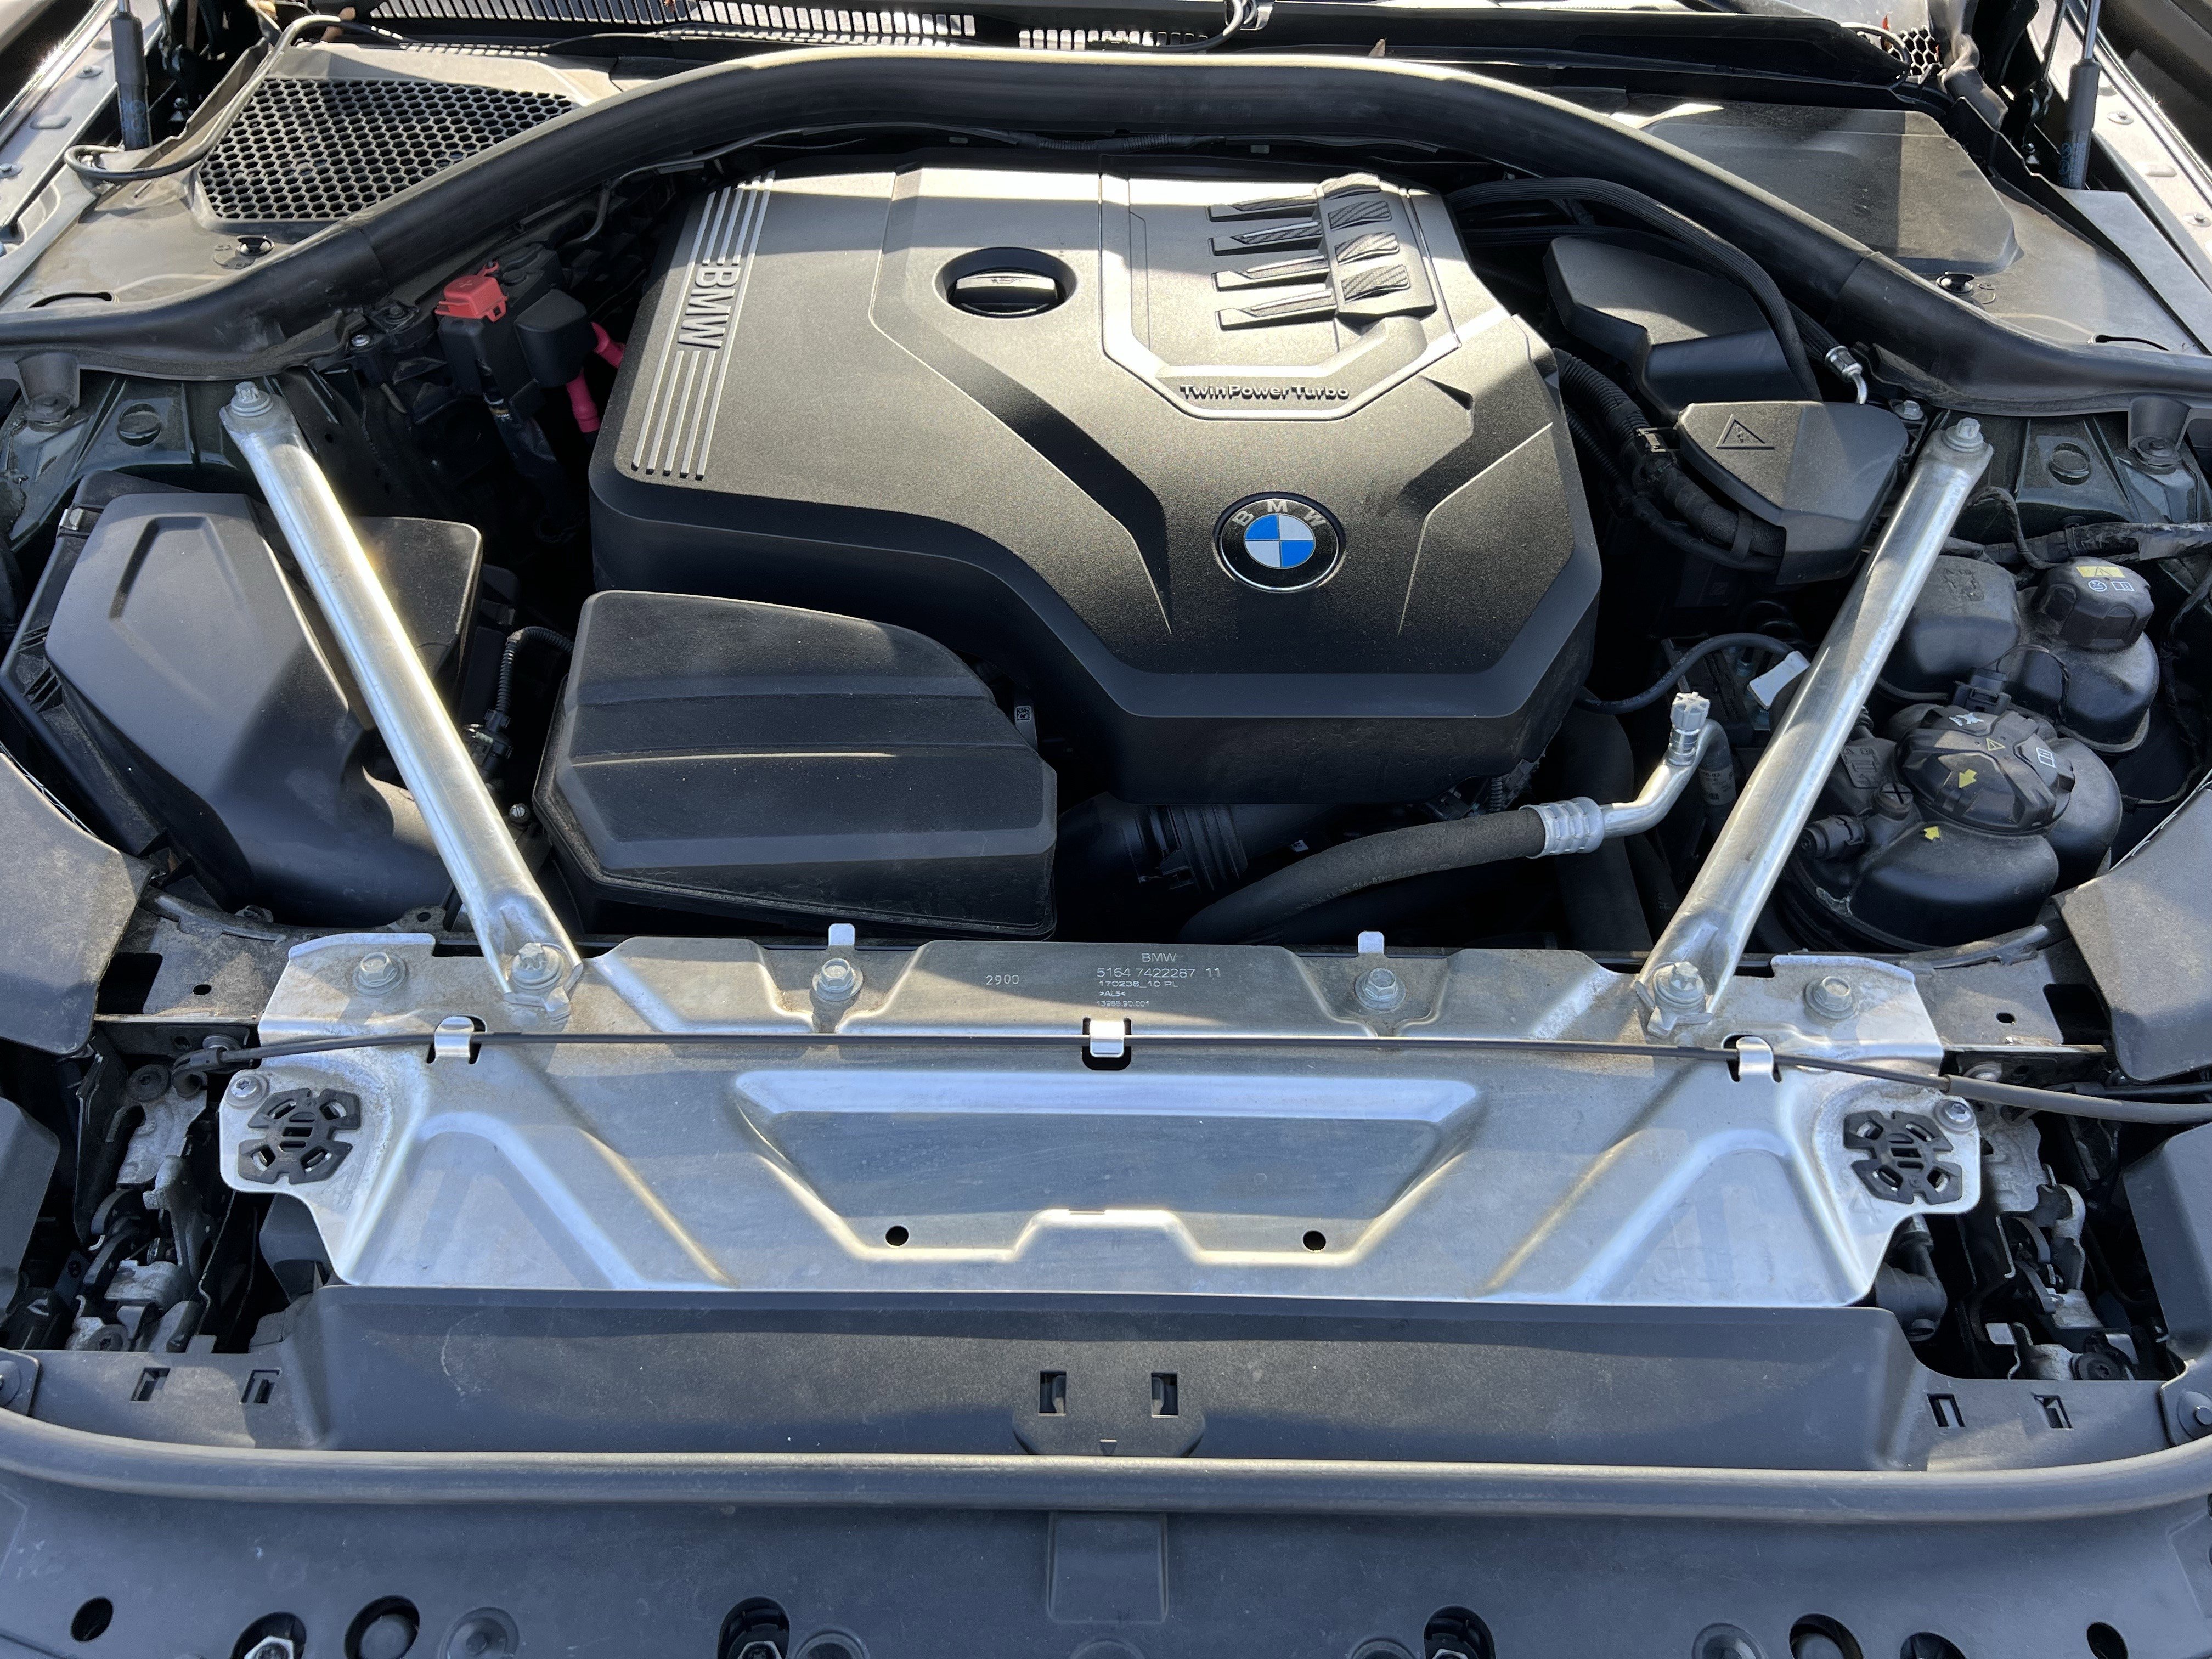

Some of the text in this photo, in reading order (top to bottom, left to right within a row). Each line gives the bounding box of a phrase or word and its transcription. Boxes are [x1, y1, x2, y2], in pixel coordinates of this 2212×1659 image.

[678, 267, 741, 349] BMW
[1232, 500, 1326, 527] BMW
[1142, 953, 1177, 962] BMW
[1097, 967, 1221, 978] 5164 7422287 11
[986, 974, 1019, 985] 2900
